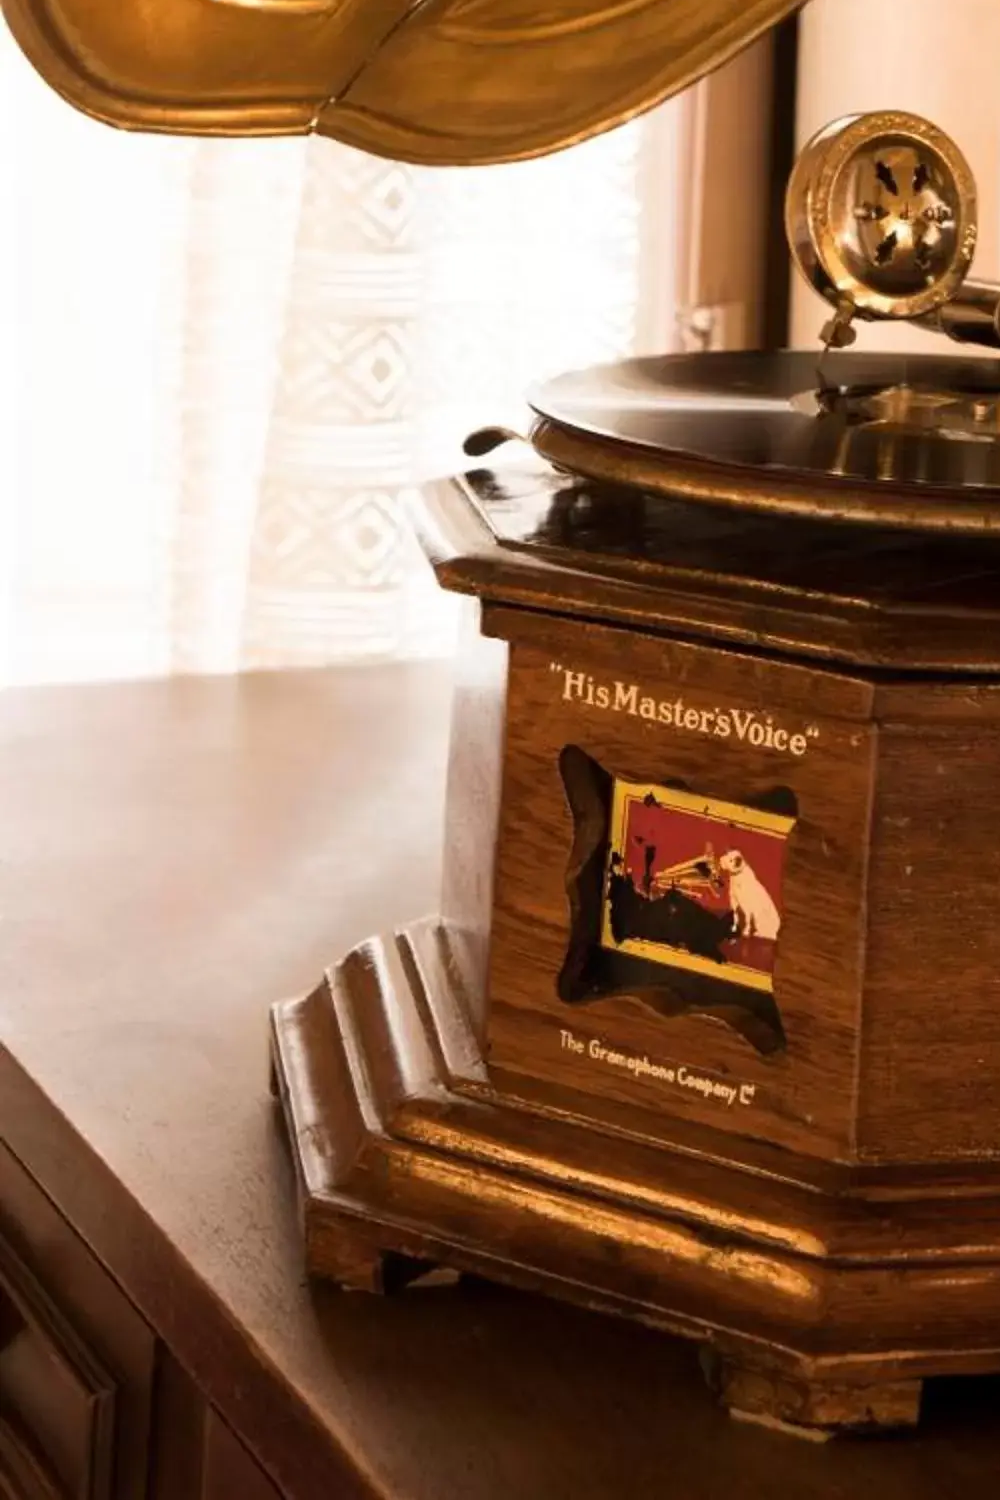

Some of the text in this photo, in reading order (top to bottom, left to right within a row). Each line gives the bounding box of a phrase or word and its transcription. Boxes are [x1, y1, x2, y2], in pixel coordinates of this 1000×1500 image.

[560, 1029, 584, 1054] The
[589, 1039, 675, 1083] Gramophone
[677, 1067, 737, 1106] Company
